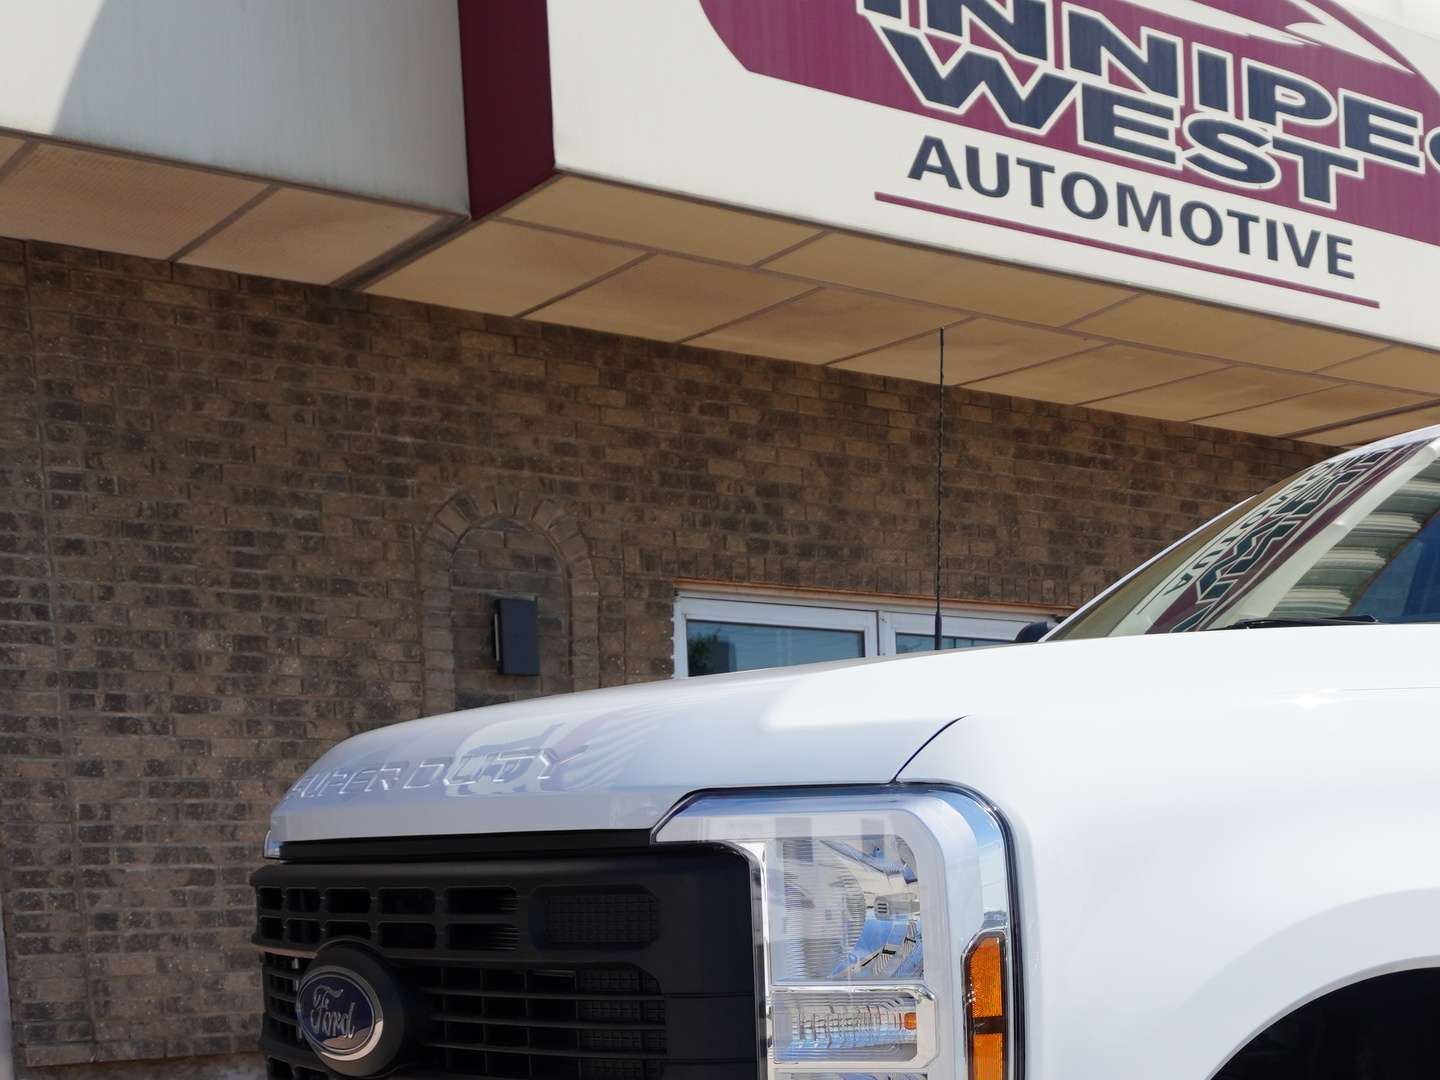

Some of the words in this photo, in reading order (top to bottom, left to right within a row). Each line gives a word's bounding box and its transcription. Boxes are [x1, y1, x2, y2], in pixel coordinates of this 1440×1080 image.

[877, 25, 1360, 206] WEST
[907, 135, 1356, 280] AUTOMOTIVE
[310, 984, 356, 1038] Ford
